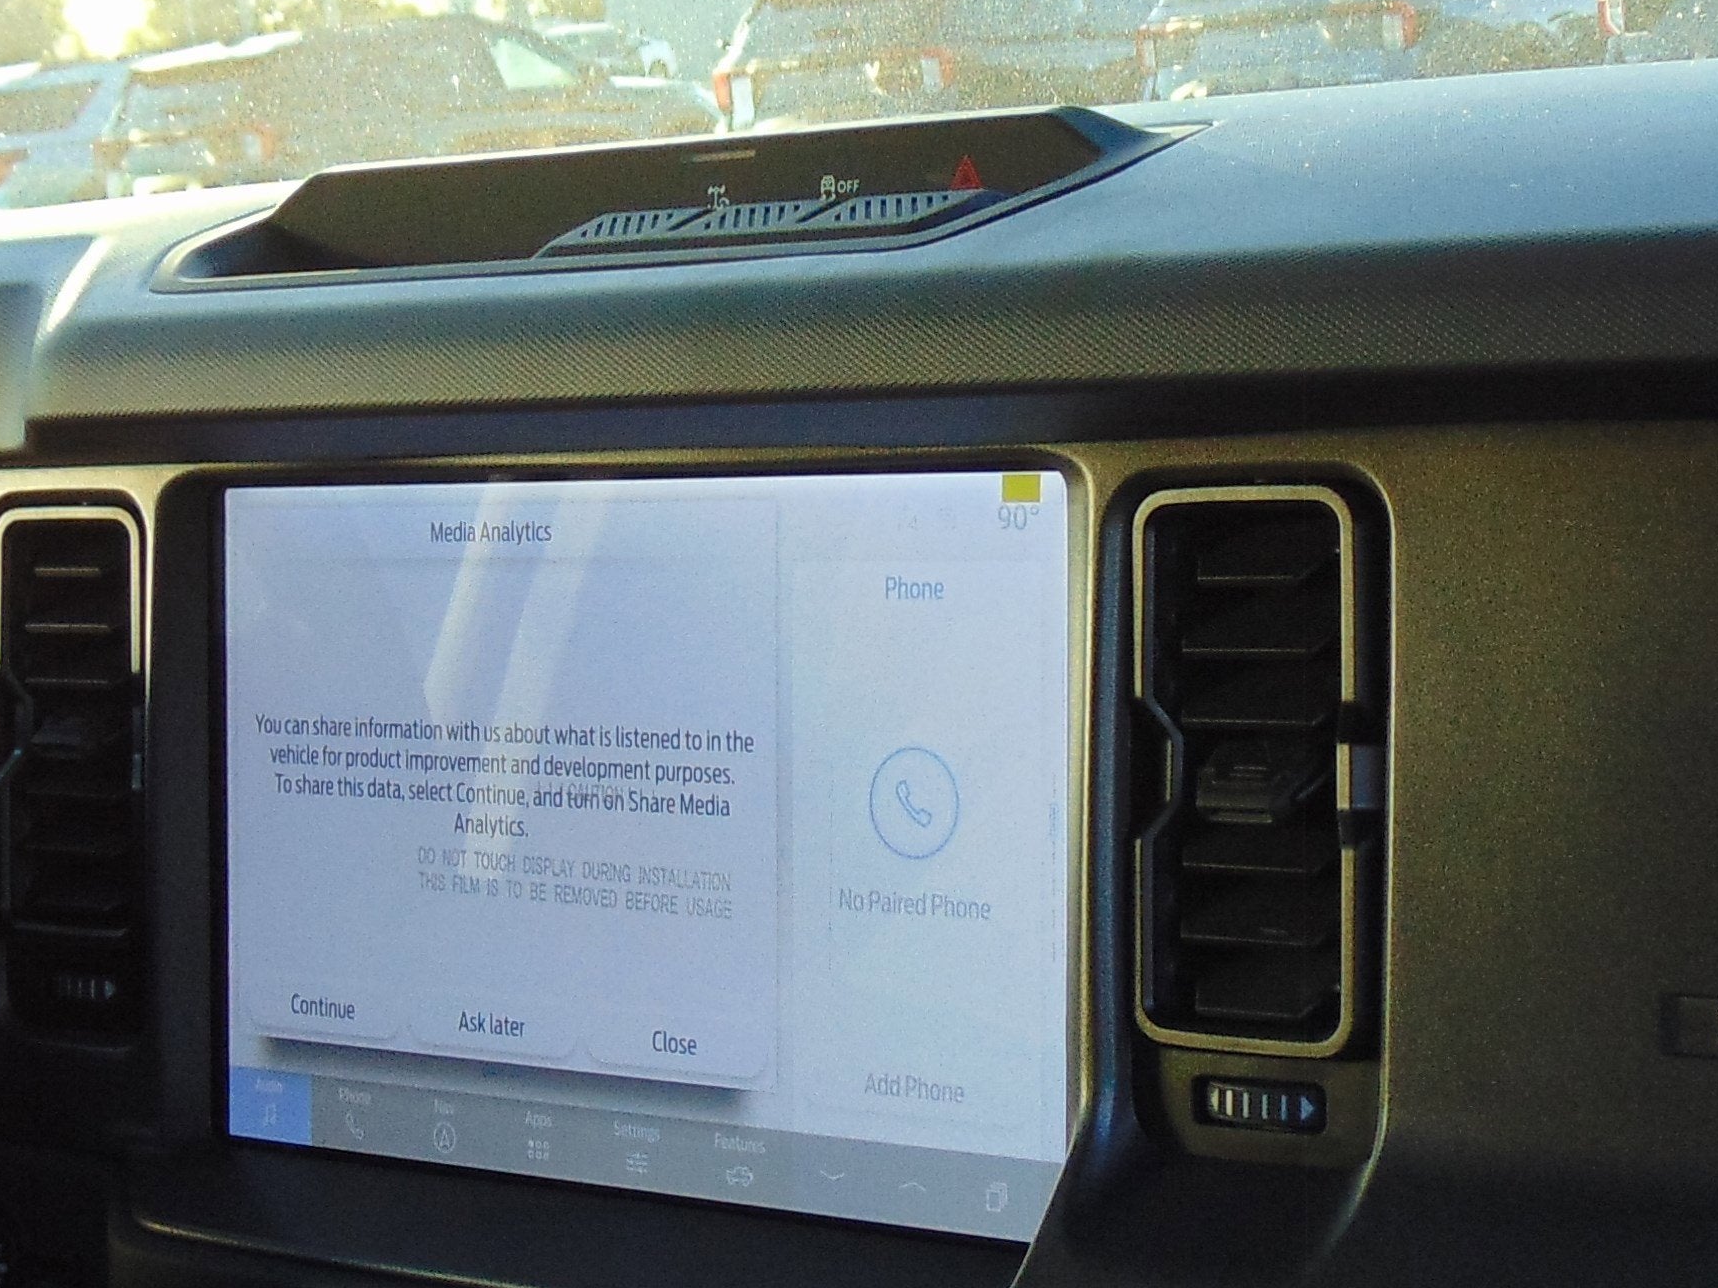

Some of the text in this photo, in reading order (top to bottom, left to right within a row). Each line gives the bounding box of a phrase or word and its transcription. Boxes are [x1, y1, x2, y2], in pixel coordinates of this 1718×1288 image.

[837, 179, 860, 194] OFF
[431, 521, 552, 546] Media Analytics
[885, 576, 945, 600] Phone
[255, 714, 754, 754] You can share information with us about what is listened to in the
[270, 744, 735, 787] vehicle for product improvement and development purposes.
[275, 774, 730, 817] To share this data, select Continue, and turn on Share Media
[454, 814, 529, 838] Analytics.
[418, 847, 731, 891] DO NOT TOUCH DISPLAY DURING INSTALLATION
[418, 872, 445, 892] THIS
[452, 874, 480, 894] FILM
[507, 878, 522, 898] TO
[529, 880, 546, 900] BE
[554, 883, 617, 908] REMOVED
[625, 888, 677, 913] BEFORE
[685, 894, 732, 919] USAGE
[839, 888, 991, 919] No Paired Phone
[291, 994, 355, 1020] Continue
[459, 1011, 525, 1038] Ask later
[652, 1031, 697, 1056] Close
[865, 1074, 964, 1104] Add Phone
[525, 1110, 552, 1129] Apps
[614, 1120, 660, 1143] Settings
[714, 1132, 766, 1155] Features
